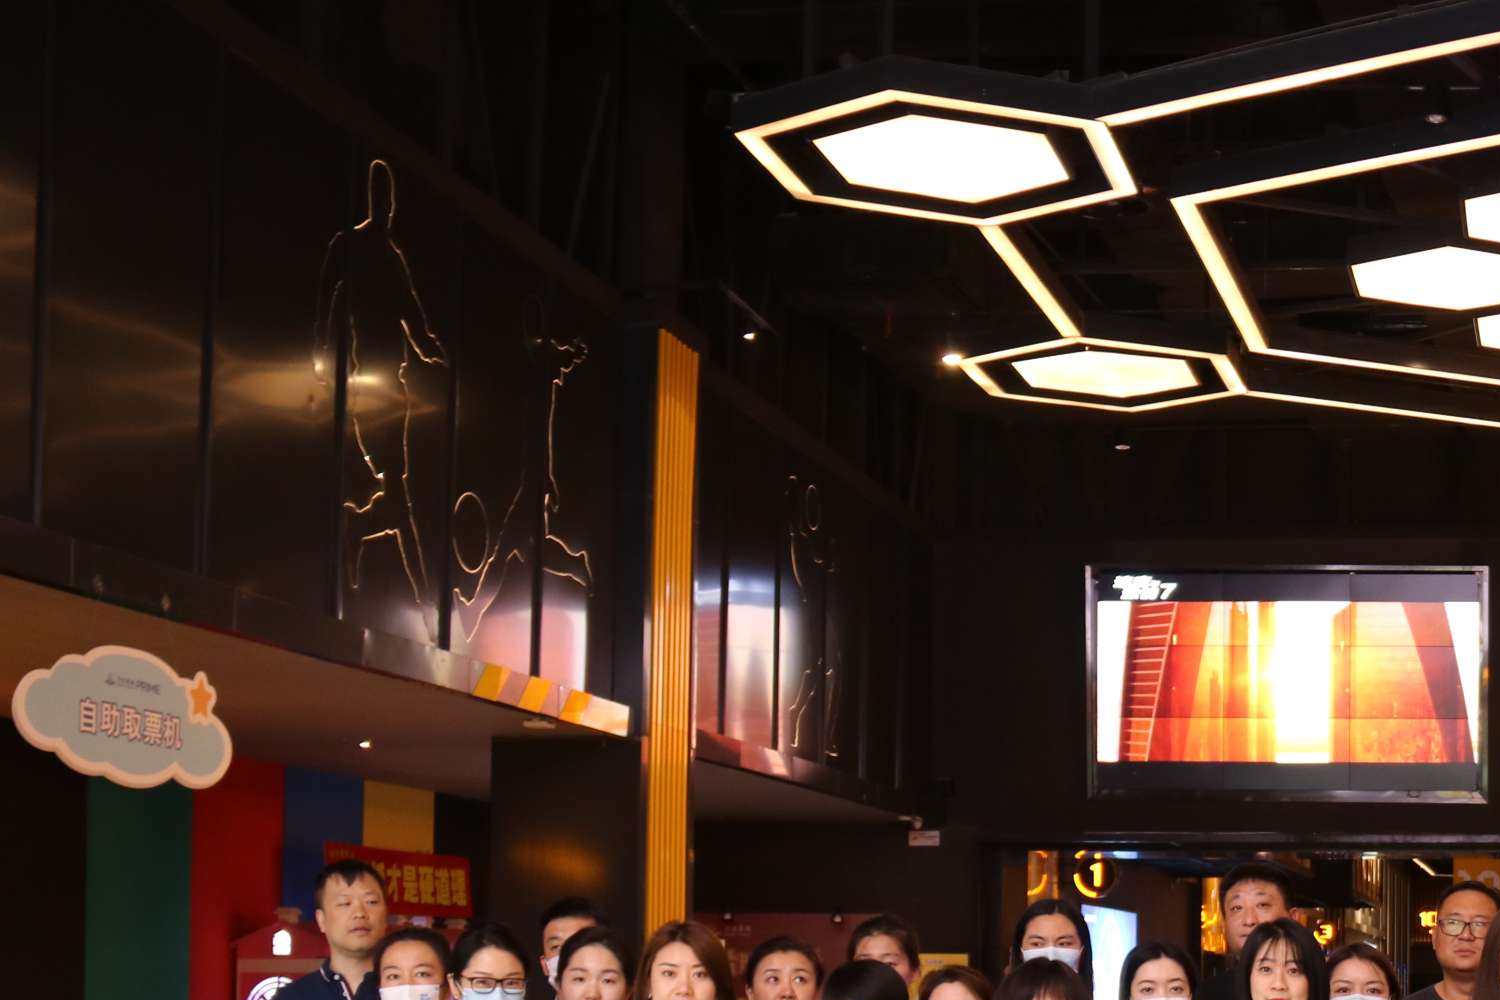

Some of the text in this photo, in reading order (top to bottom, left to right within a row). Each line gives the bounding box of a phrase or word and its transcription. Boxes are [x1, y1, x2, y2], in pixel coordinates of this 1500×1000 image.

[79, 696, 183, 751] 自助取票机
[374, 861, 467, 906] 才是硬道理
